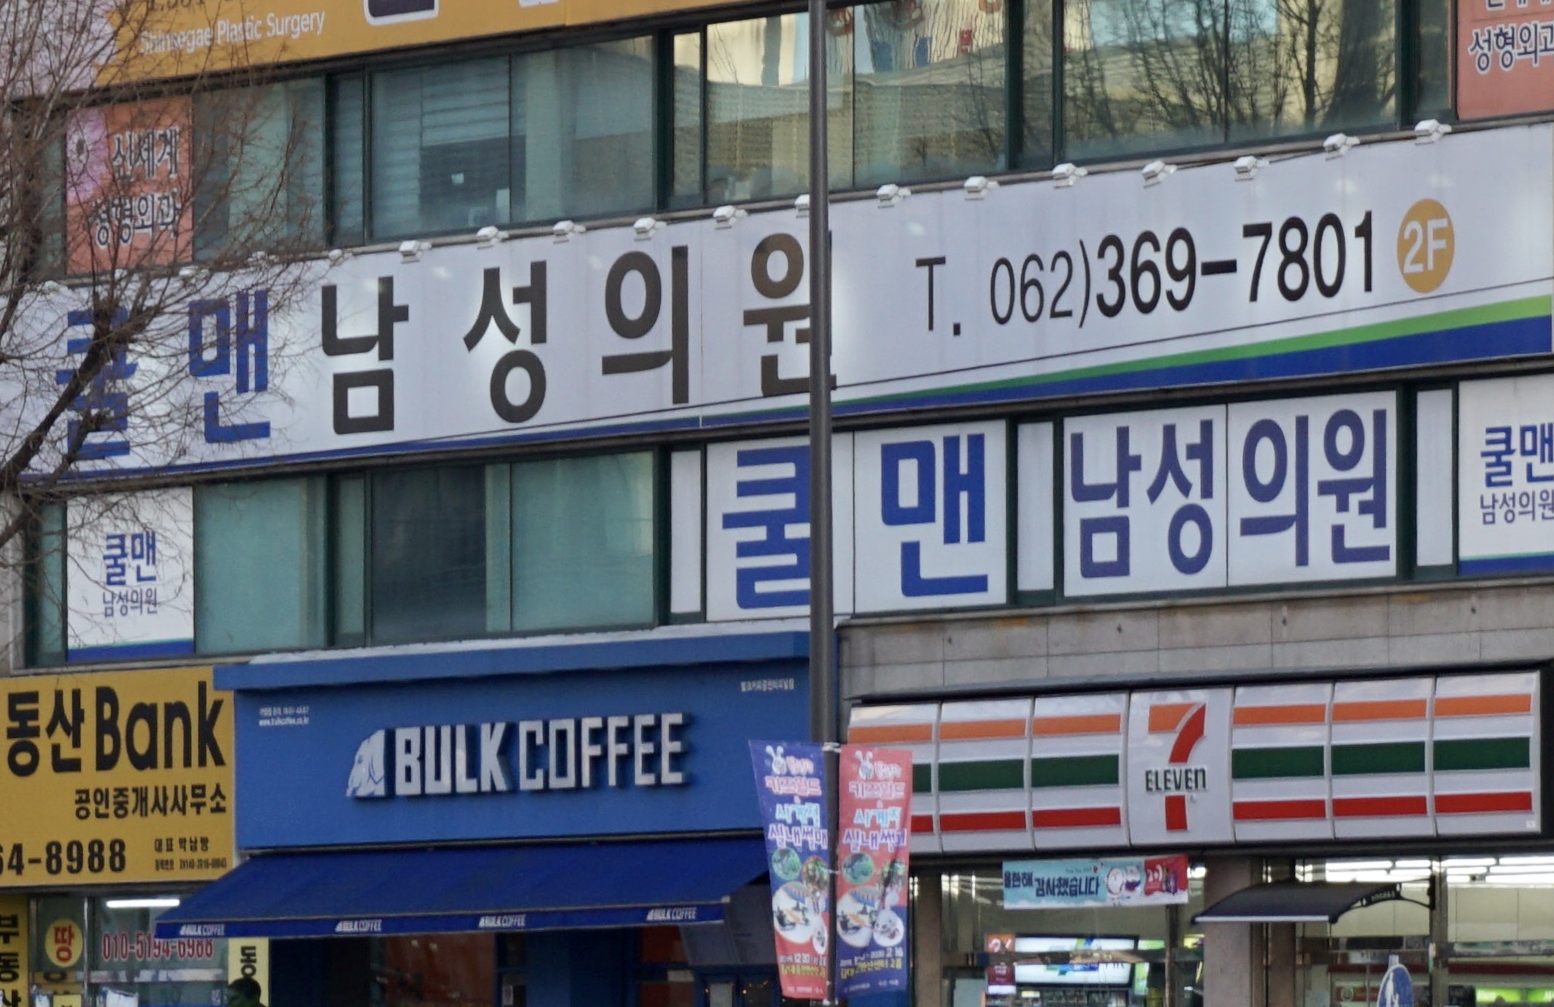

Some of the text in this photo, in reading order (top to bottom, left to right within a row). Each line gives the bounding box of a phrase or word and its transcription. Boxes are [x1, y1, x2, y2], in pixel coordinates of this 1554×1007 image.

[217, 15, 263, 45] Plastic
[266, 10, 326, 39] Surgery
[1400, 218, 1449, 274] 2F
[320, 229, 837, 435] 남성의원
[1069, 407, 1392, 580] 남성의원
[103, 529, 157, 586] 쿨맨
[102, 587, 158, 618] 남성의원
[95, 680, 227, 772] Bank
[393, 712, 687, 797] BULK COFFEE
[74, 783, 227, 821] 공인중개사사무소
[1035, 875, 1100, 898] 감사했습니다
[53, 924, 75, 964] 땅
